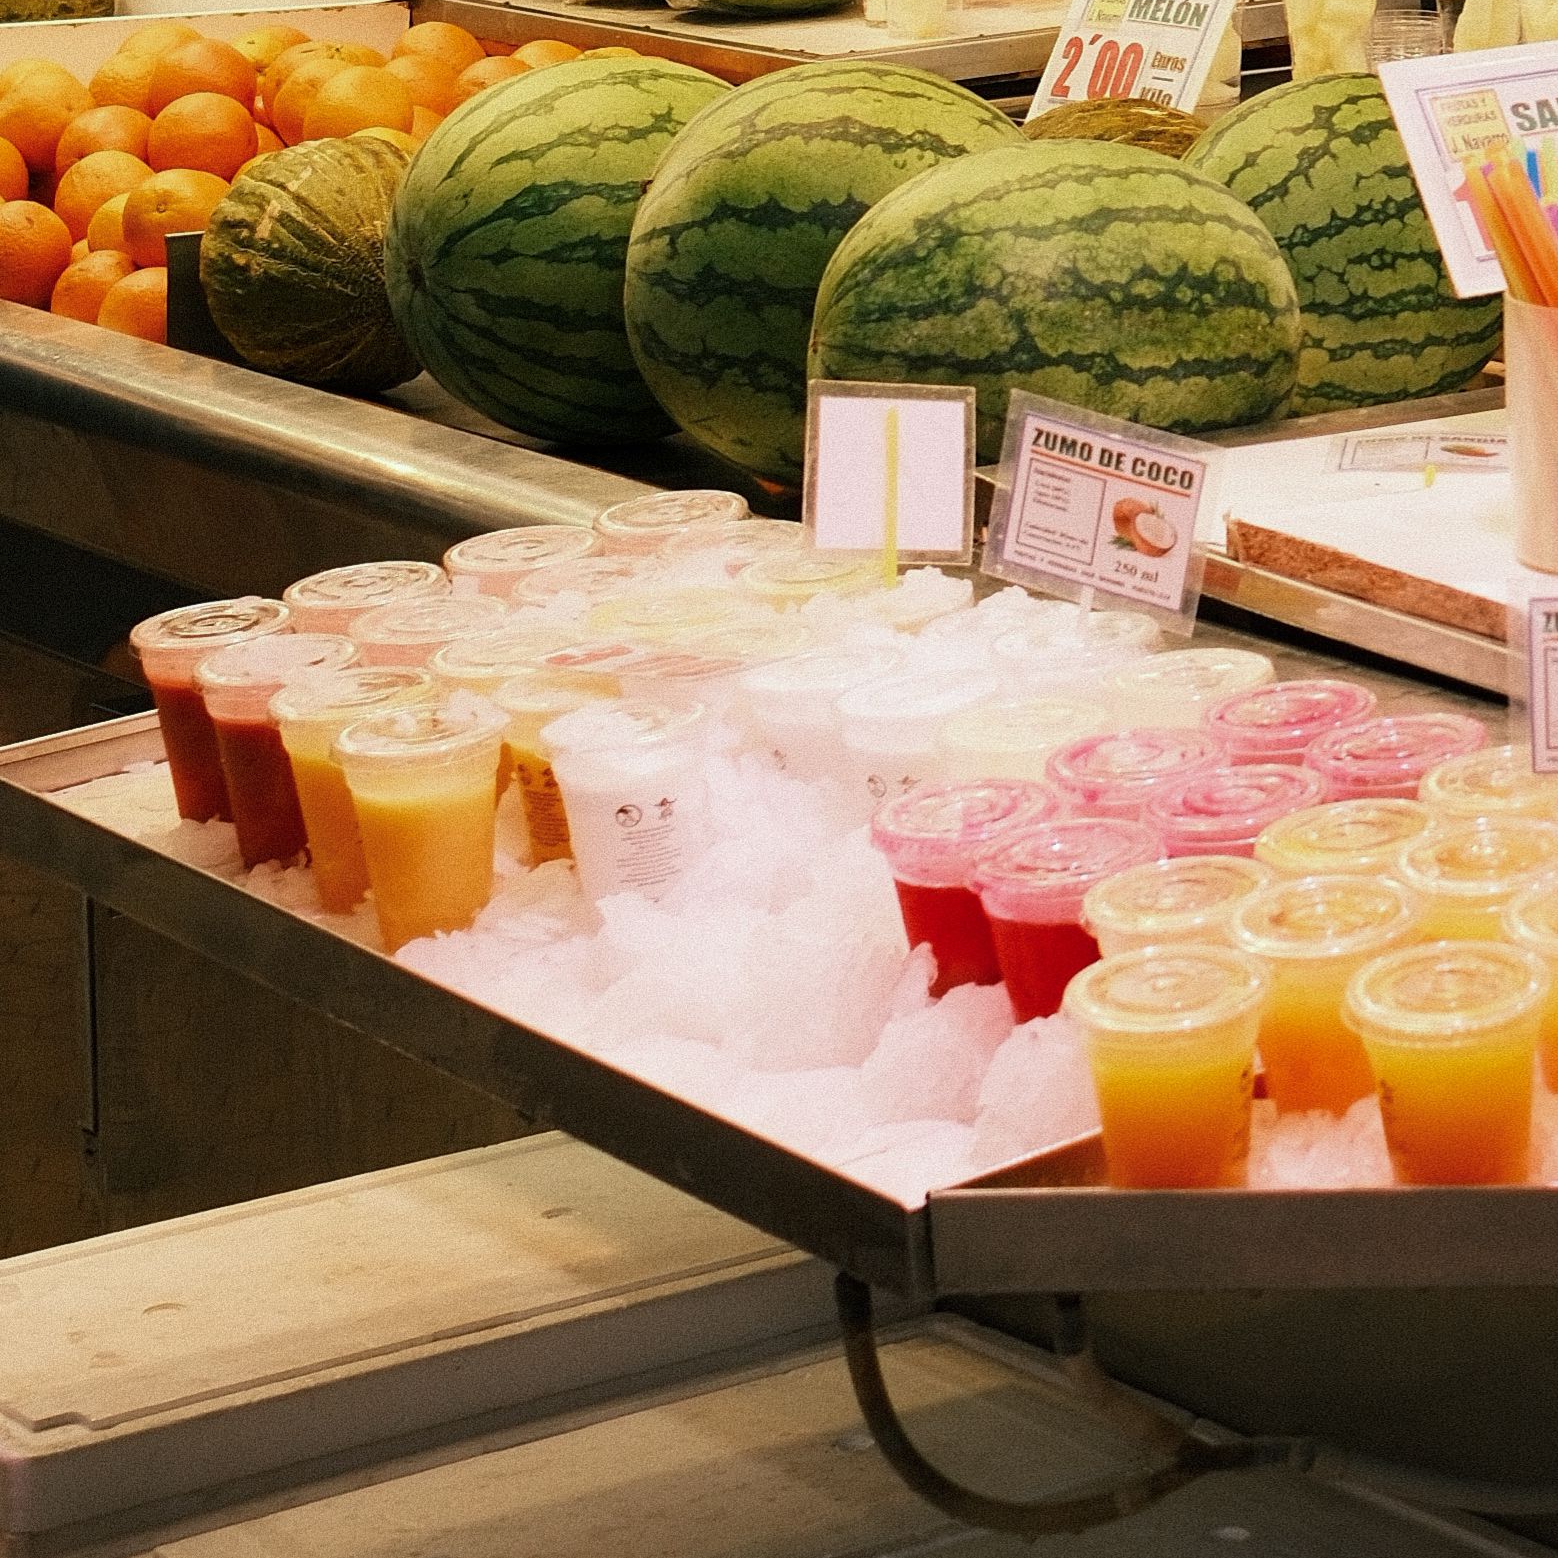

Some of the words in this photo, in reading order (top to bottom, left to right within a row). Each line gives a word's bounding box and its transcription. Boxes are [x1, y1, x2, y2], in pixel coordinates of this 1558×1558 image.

[1150, 51, 1187, 73] Euros
[1032, 427, 1093, 462] ZUMO
[1099, 446, 1127, 472] DE
[1131, 456, 1195, 490] COCO
[1114, 560, 1138, 577] 250
[1141, 569, 1159, 583] ml
